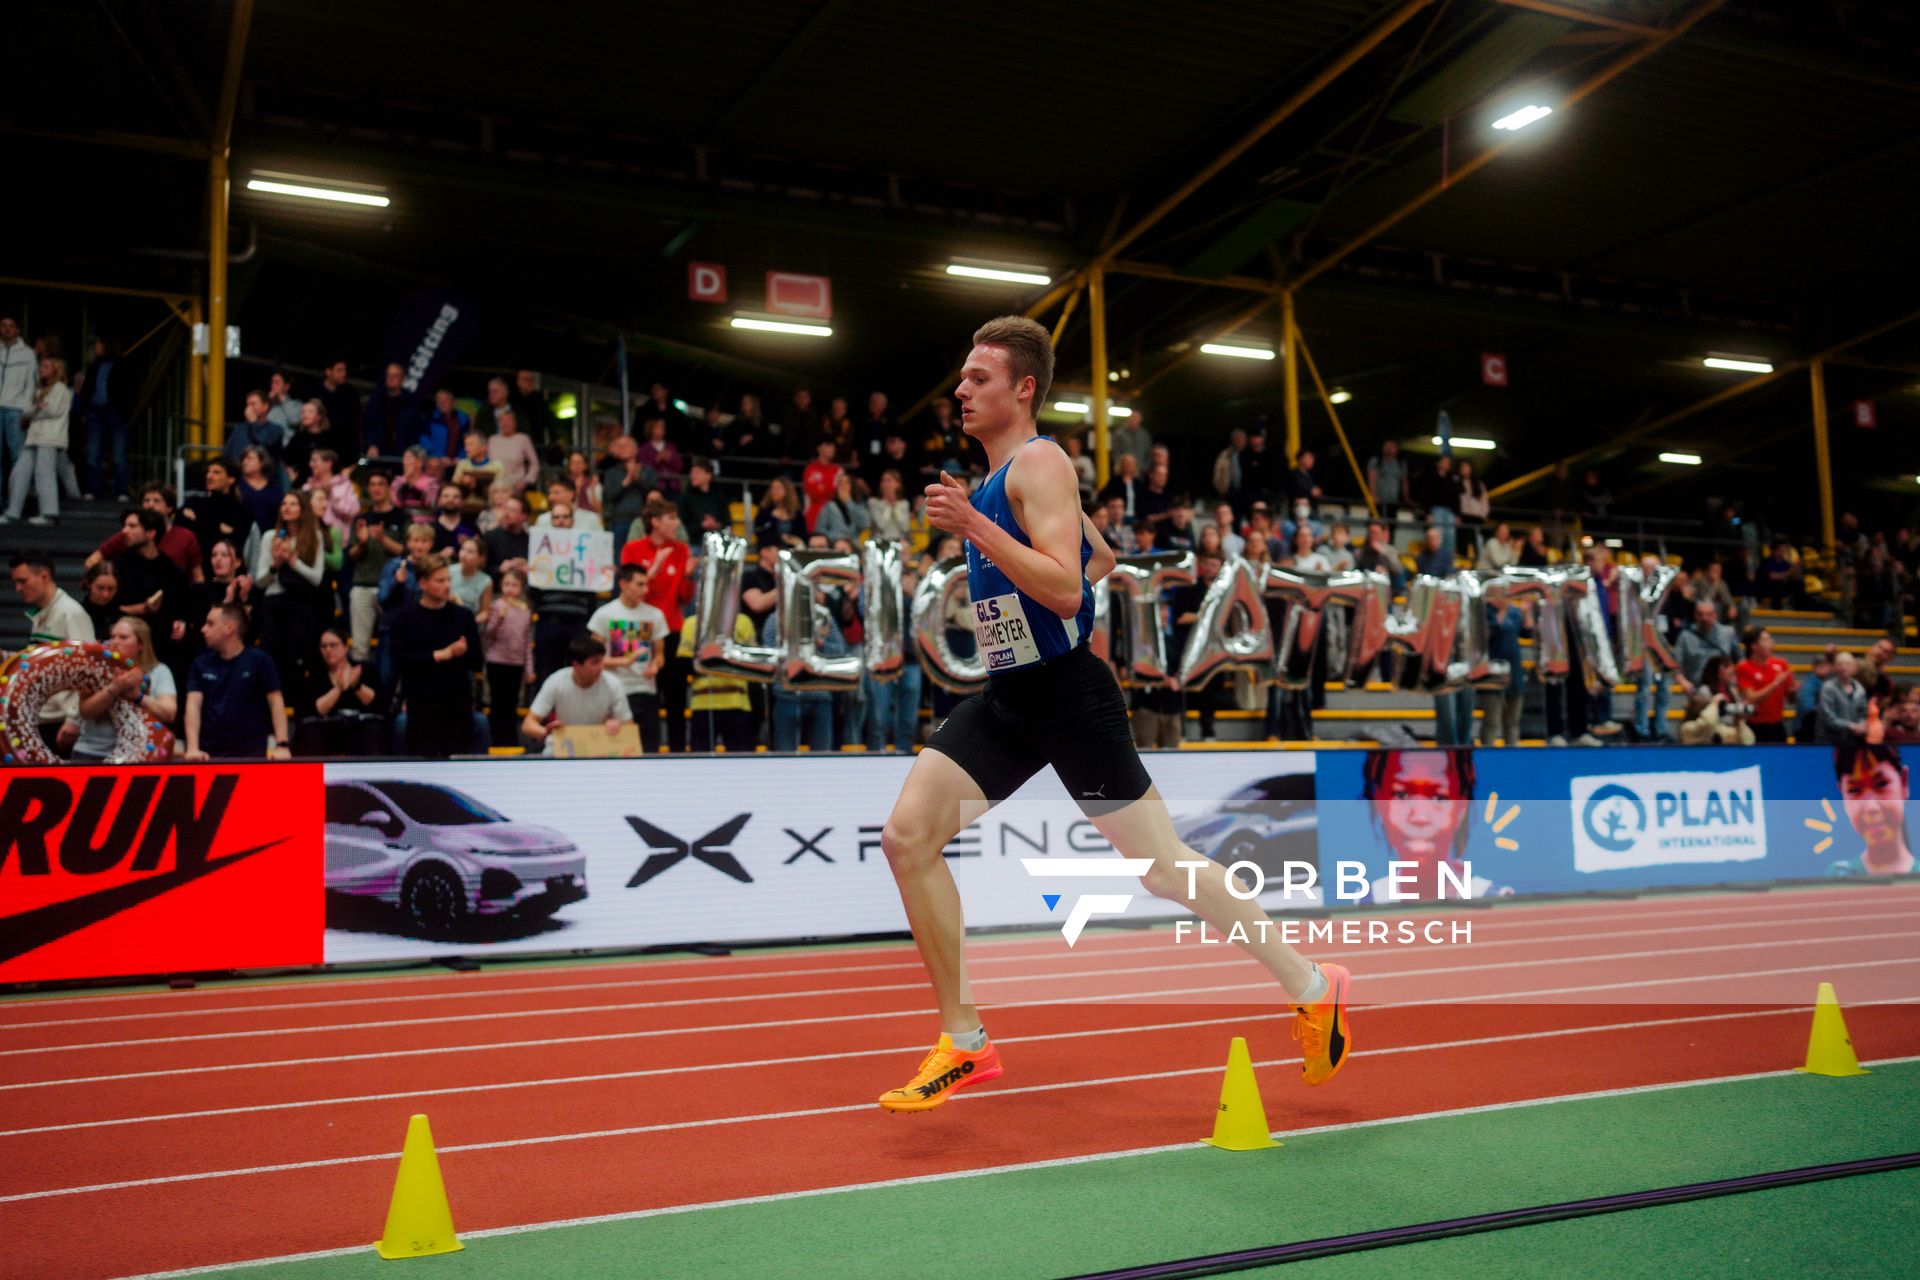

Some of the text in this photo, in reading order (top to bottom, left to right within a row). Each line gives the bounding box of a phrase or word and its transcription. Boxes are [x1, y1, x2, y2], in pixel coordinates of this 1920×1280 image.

[695, 268, 720, 295] D
[1486, 358, 1503, 381] C
[537, 533, 590, 560] Auf
[1655, 790, 1754, 827] PLAN
[0, 774, 240, 876] RUN
[1658, 835, 1757, 849] INTERNATIONAL
[913, 1061, 975, 1100] NITRO
